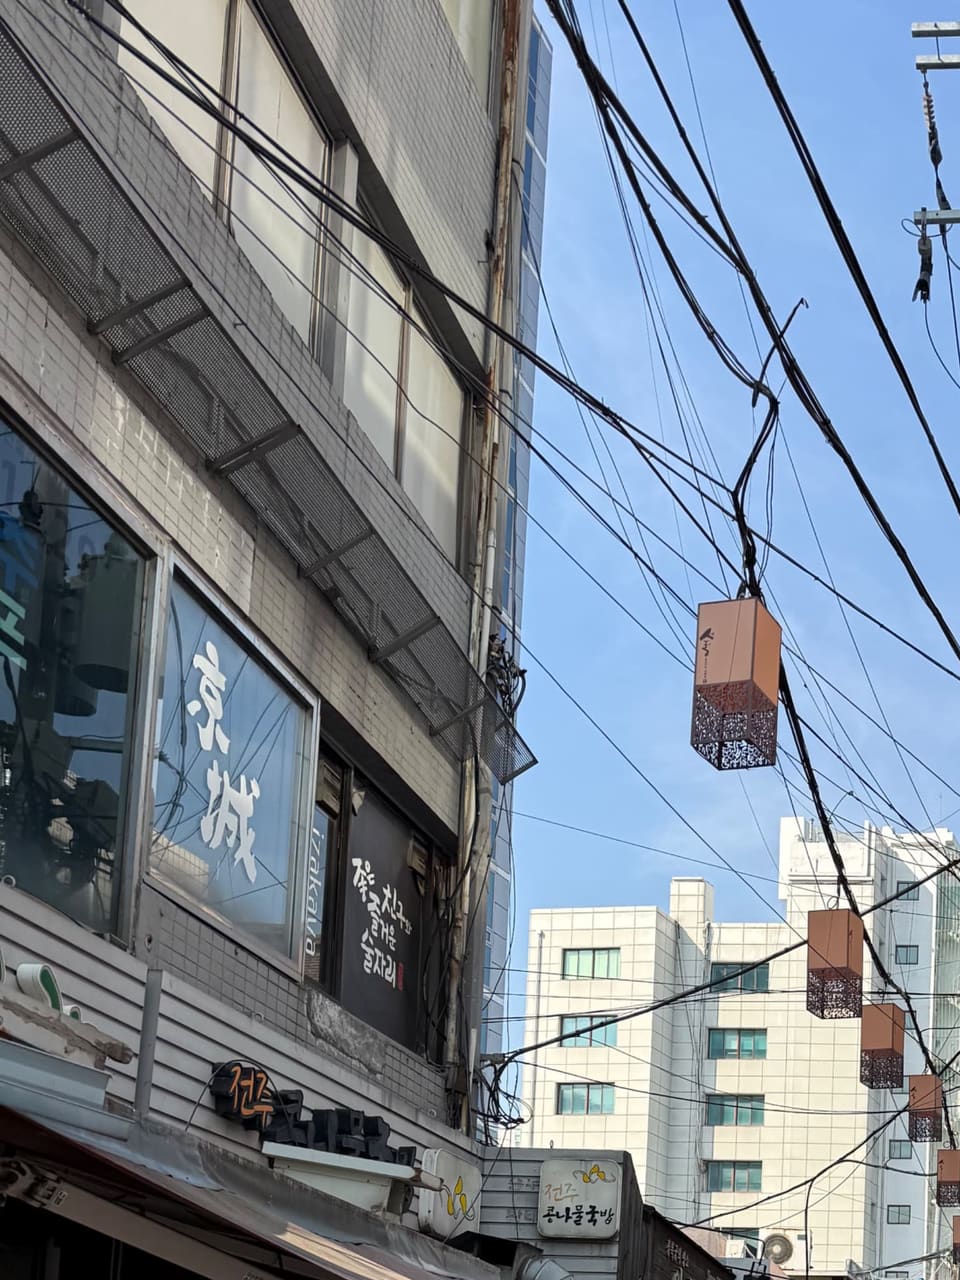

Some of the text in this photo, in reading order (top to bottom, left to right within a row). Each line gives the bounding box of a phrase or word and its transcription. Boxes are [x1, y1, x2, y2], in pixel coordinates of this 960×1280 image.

[187, 640, 260, 886] 京城
[360, 928, 397, 990] 술자리
[230, 1065, 274, 1129] 전주
[545, 1183, 579, 1203] 전주
